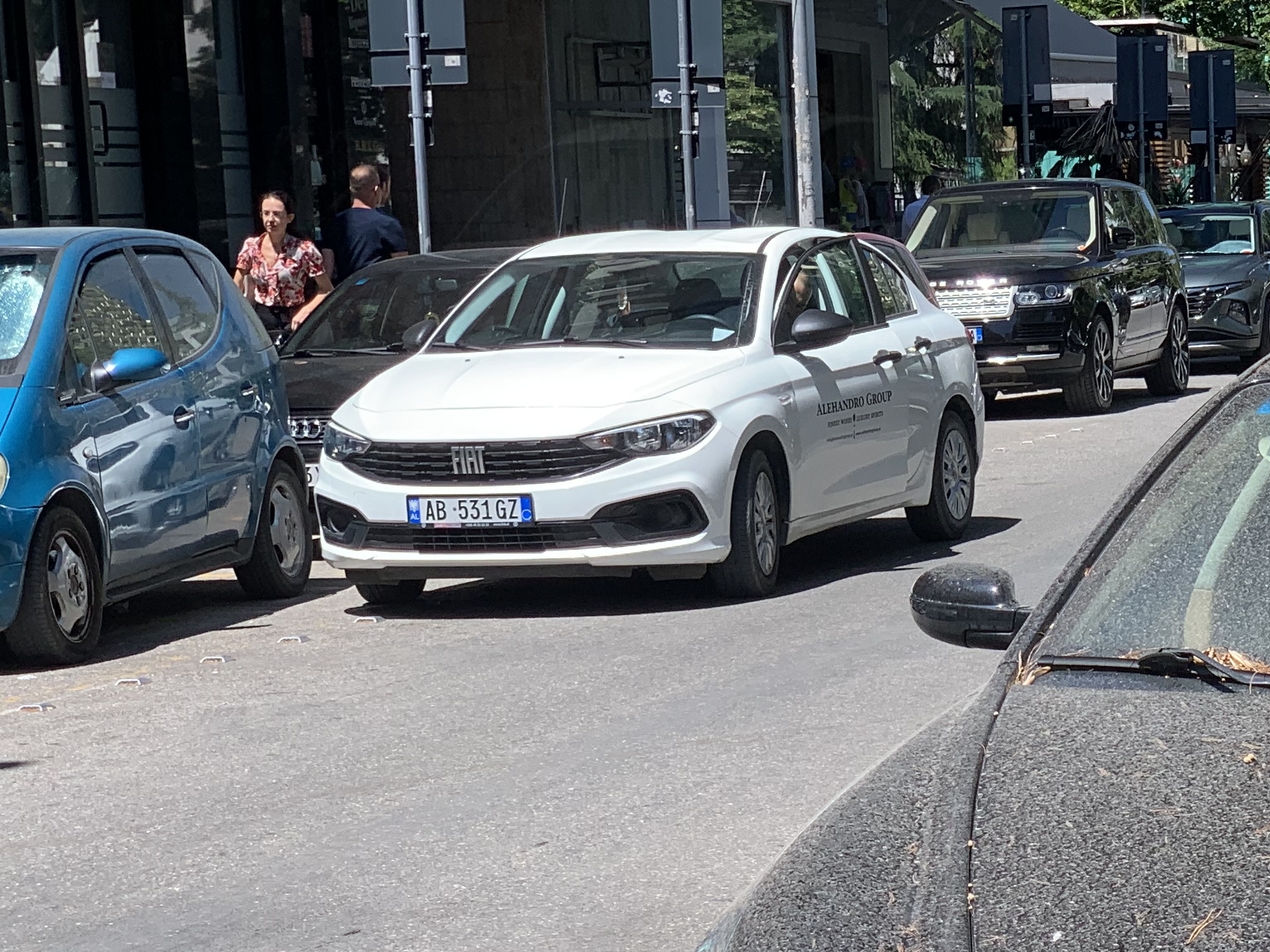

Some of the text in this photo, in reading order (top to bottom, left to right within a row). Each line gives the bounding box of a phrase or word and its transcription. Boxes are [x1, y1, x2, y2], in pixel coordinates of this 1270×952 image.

[816, 390, 893, 416] ALEHANDRO GROUP
[451, 446, 486, 474] FIAT
[426, 500, 447, 520] AB
